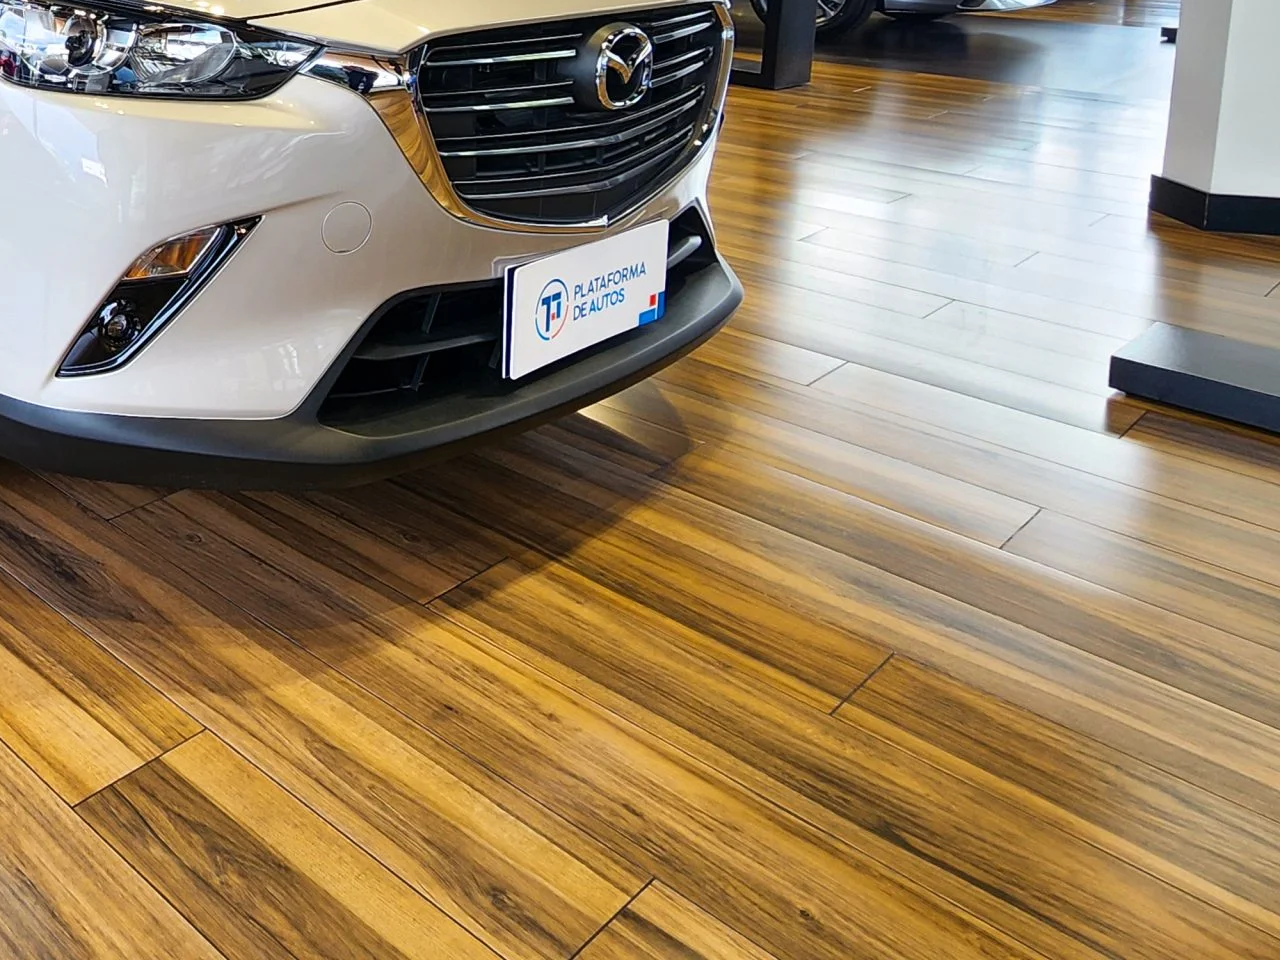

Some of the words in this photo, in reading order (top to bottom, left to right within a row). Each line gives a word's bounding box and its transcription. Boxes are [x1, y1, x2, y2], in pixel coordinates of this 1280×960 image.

[573, 261, 647, 300] PLATAFORMA
[573, 303, 587, 321] DE
[589, 287, 625, 315] AUTOS
